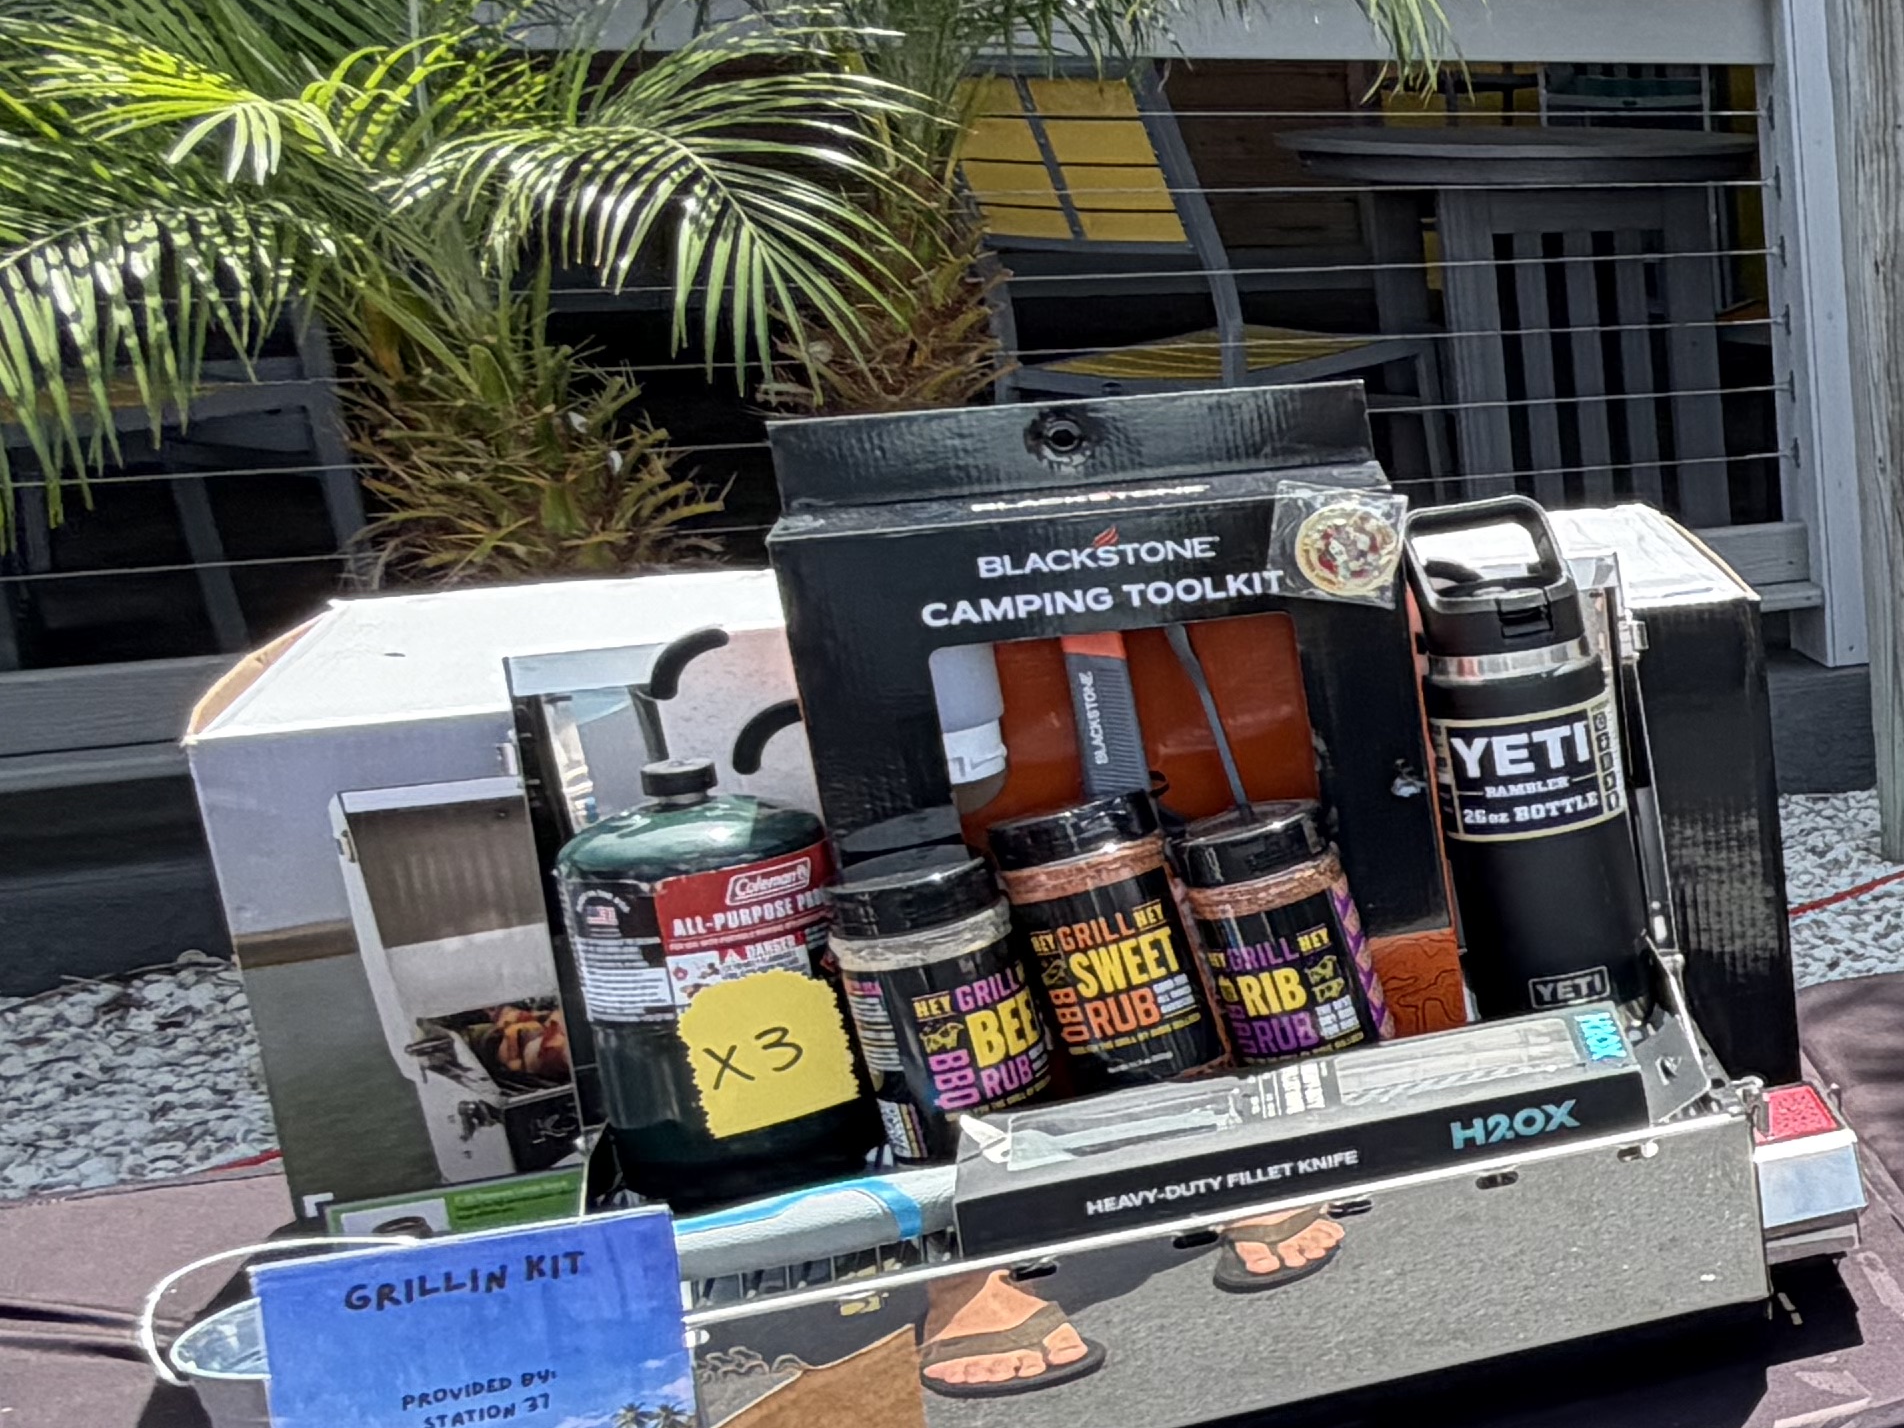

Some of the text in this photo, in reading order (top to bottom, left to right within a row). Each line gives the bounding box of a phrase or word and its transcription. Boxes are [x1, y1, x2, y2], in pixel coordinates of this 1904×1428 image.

[977, 535, 1217, 579] BLACKSTONE
[922, 570, 1284, 629] CAMPING TOOLKIT
[1078, 670, 1110, 766] BLACKSTONE
[1450, 720, 1592, 779] YETI
[1485, 776, 1570, 799] RAMBLER
[1513, 790, 1600, 823] BOTTLE
[732, 861, 803, 898] Coleman
[672, 896, 794, 939] ALL-PURPOSE
[1056, 912, 1136, 952] GRILL
[1132, 904, 1164, 928] HEY
[1068, 926, 1180, 999] SWEET
[1226, 926, 1330, 971] GRILL HEY
[913, 968, 1020, 1019] HEY GRILL
[1085, 987, 1161, 1039] RUB
[1236, 966, 1308, 1018] RIB
[1535, 973, 1602, 1003] YETI
[1049, 986, 1091, 1043] BBQ
[1253, 1011, 1320, 1054] RUB
[927, 1049, 982, 1110] BBQ
[980, 1055, 1034, 1100] RUB
[1450, 1096, 1583, 1152] H2OX
[1085, 1148, 1360, 1216] HEAVY-DUTY FILLET KNIFE
[343, 1250, 585, 1313] GRILLIN KIT
[401, 1375, 514, 1412] PROVIDED
